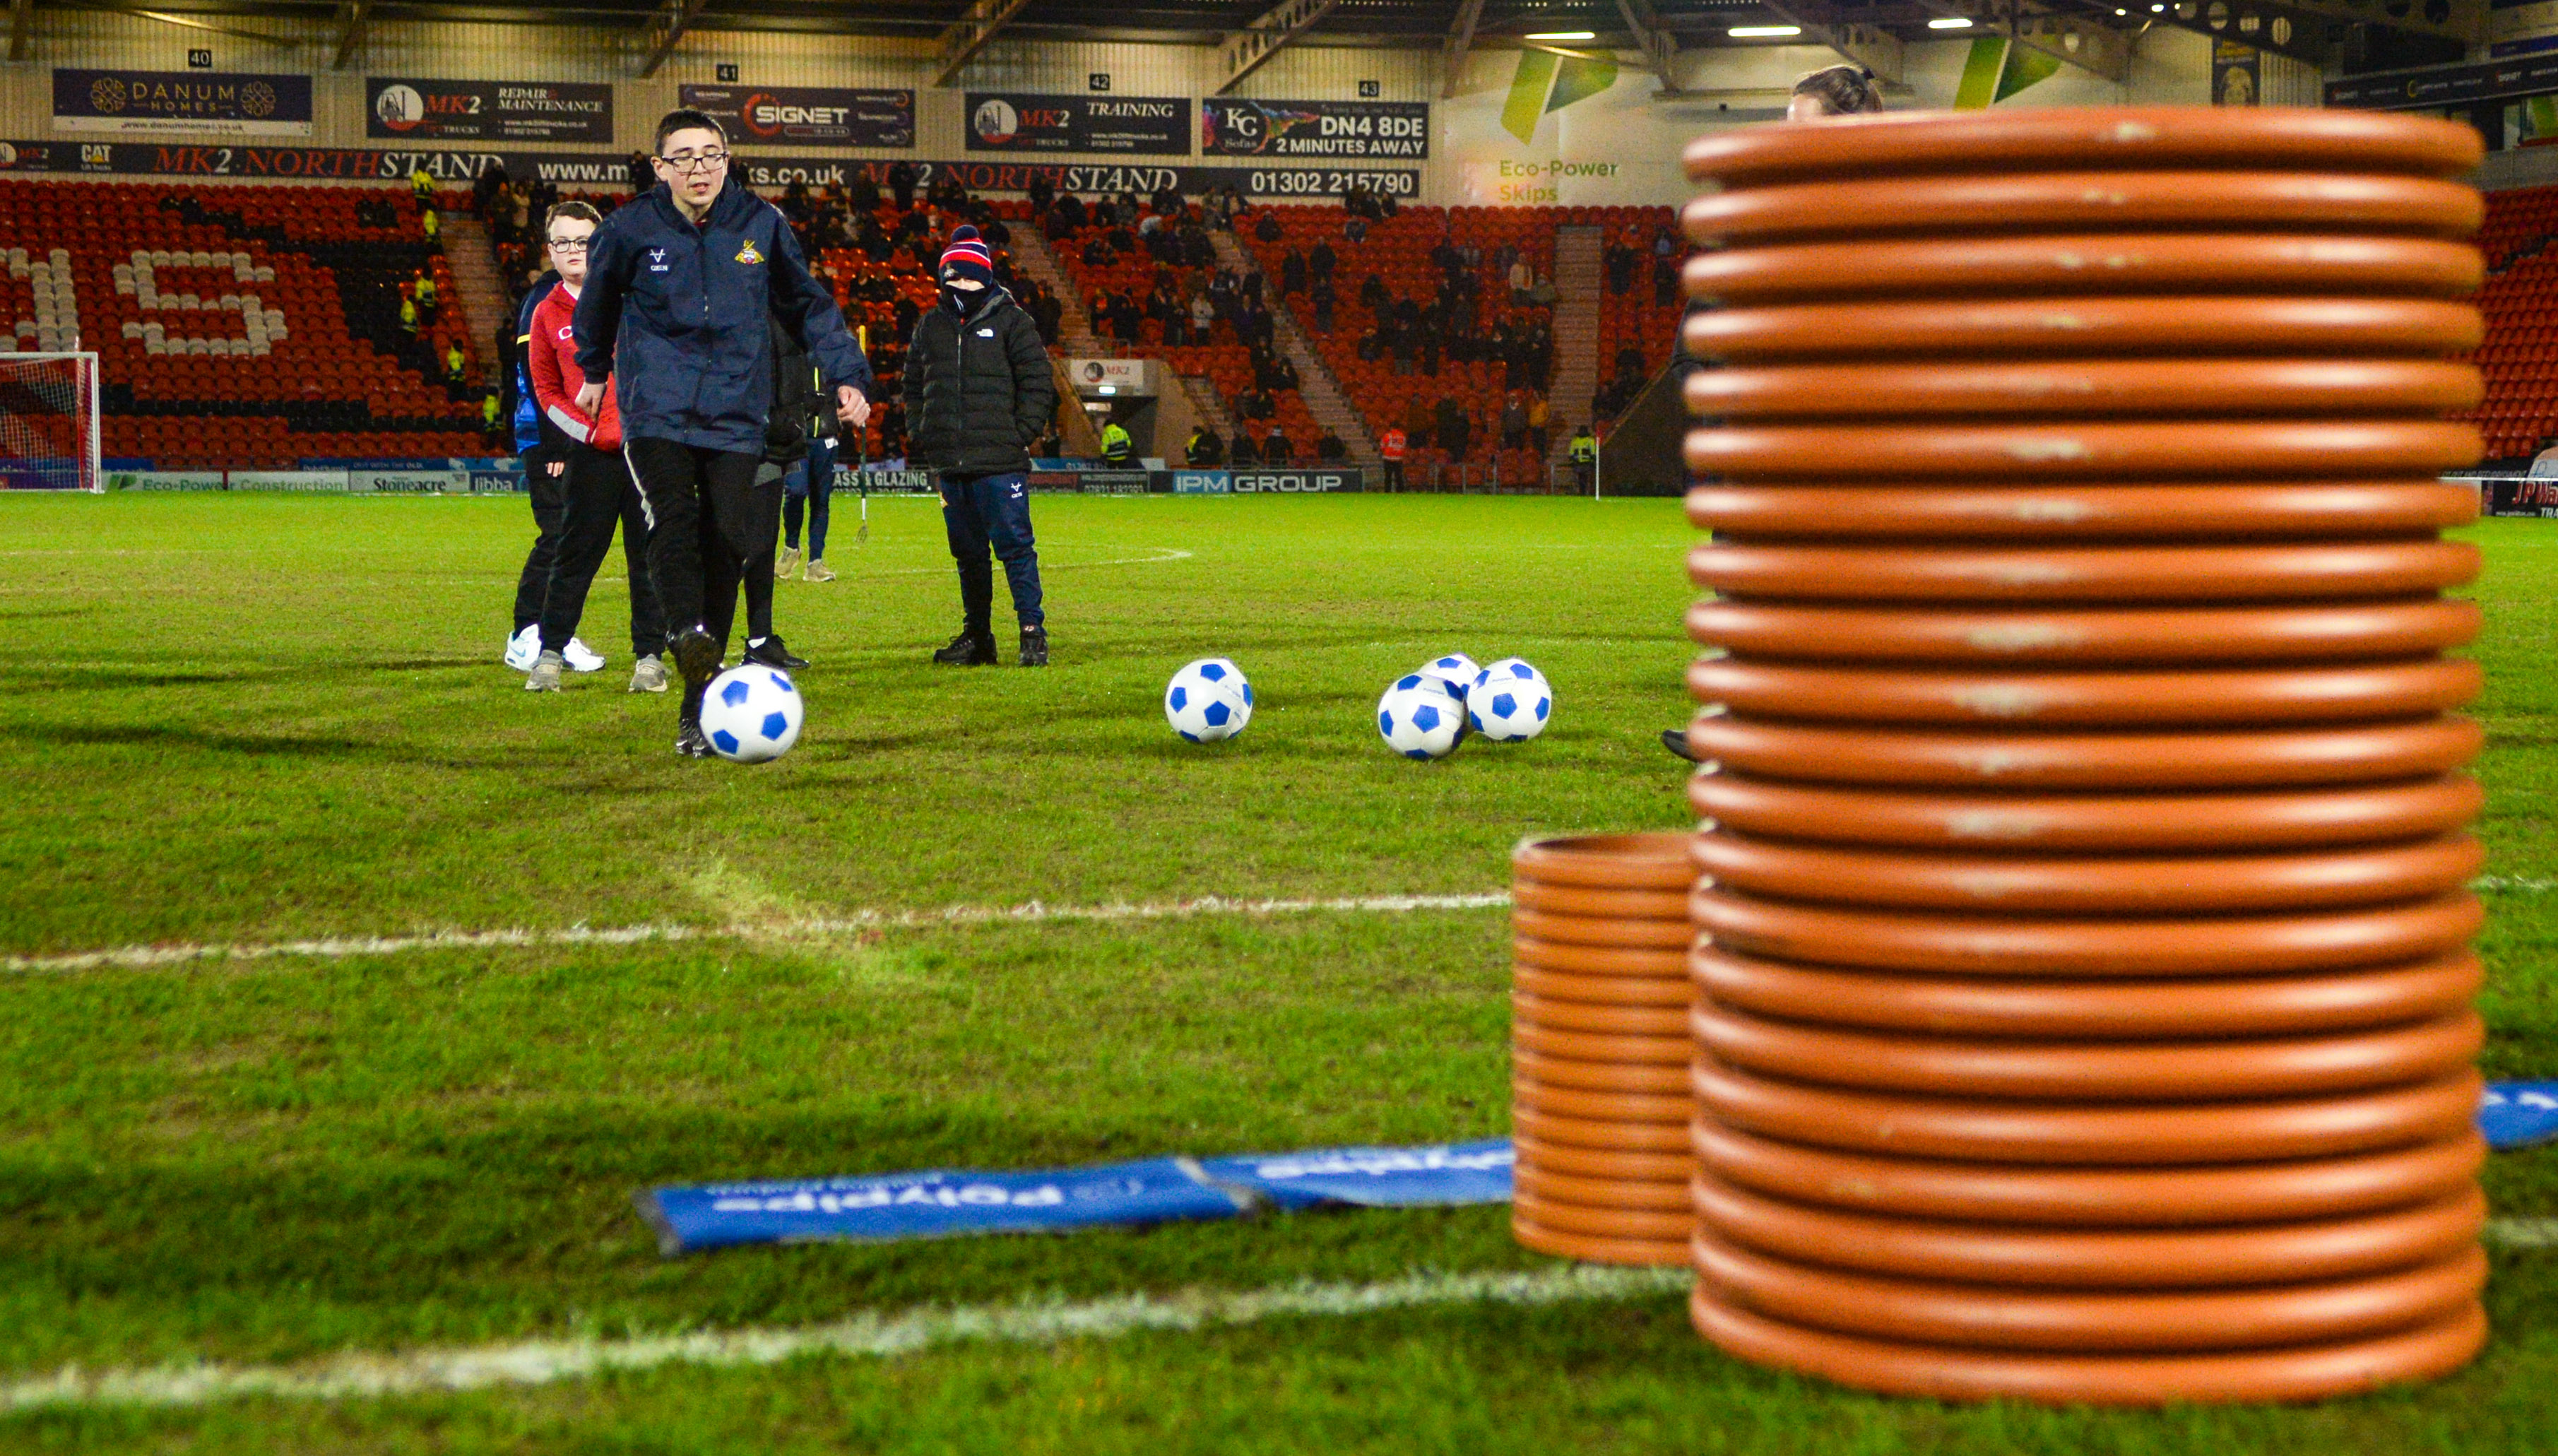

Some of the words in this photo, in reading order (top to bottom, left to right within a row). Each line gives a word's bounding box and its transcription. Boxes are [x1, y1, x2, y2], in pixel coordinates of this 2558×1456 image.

[191, 51, 210, 66] 40
[719, 66, 737, 79] 41
[133, 81, 235, 101] DANUM
[1091, 76, 1109, 89] 42
[1361, 83, 1378, 96] 43
[498, 87, 547, 100] REPAIR
[150, 100, 217, 113] HOMES
[425, 94, 482, 115] MK2
[497, 99, 603, 113] MAINTENANCE
[1086, 101, 1174, 118] TRAINING
[755, 107, 848, 124] SIGNET
[1019, 110, 1070, 128] MK2
[1226, 107, 1258, 137] KC
[1320, 116, 1372, 137] DN4
[1378, 116, 1423, 138] 8DE
[81, 143, 112, 163] CAT
[1277, 138, 1287, 153] 2
[1290, 138, 1366, 154] MINUTES
[1369, 140, 1425, 155] AWAY
[153, 147, 233, 174] MK2
[1499, 159, 1621, 177] Eco-Power
[1250, 171, 1322, 193] 01302
[1328, 172, 1413, 194] 215790
[1498, 184, 1558, 204] Skips
[142, 478, 236, 492] Eco-Power
[240, 478, 344, 492] Construction
[374, 477, 446, 491] Stoneacre
[874, 472, 928, 487] GLAZING
[1176, 475, 1228, 492] IPM
[1234, 475, 1342, 492] GROUP
